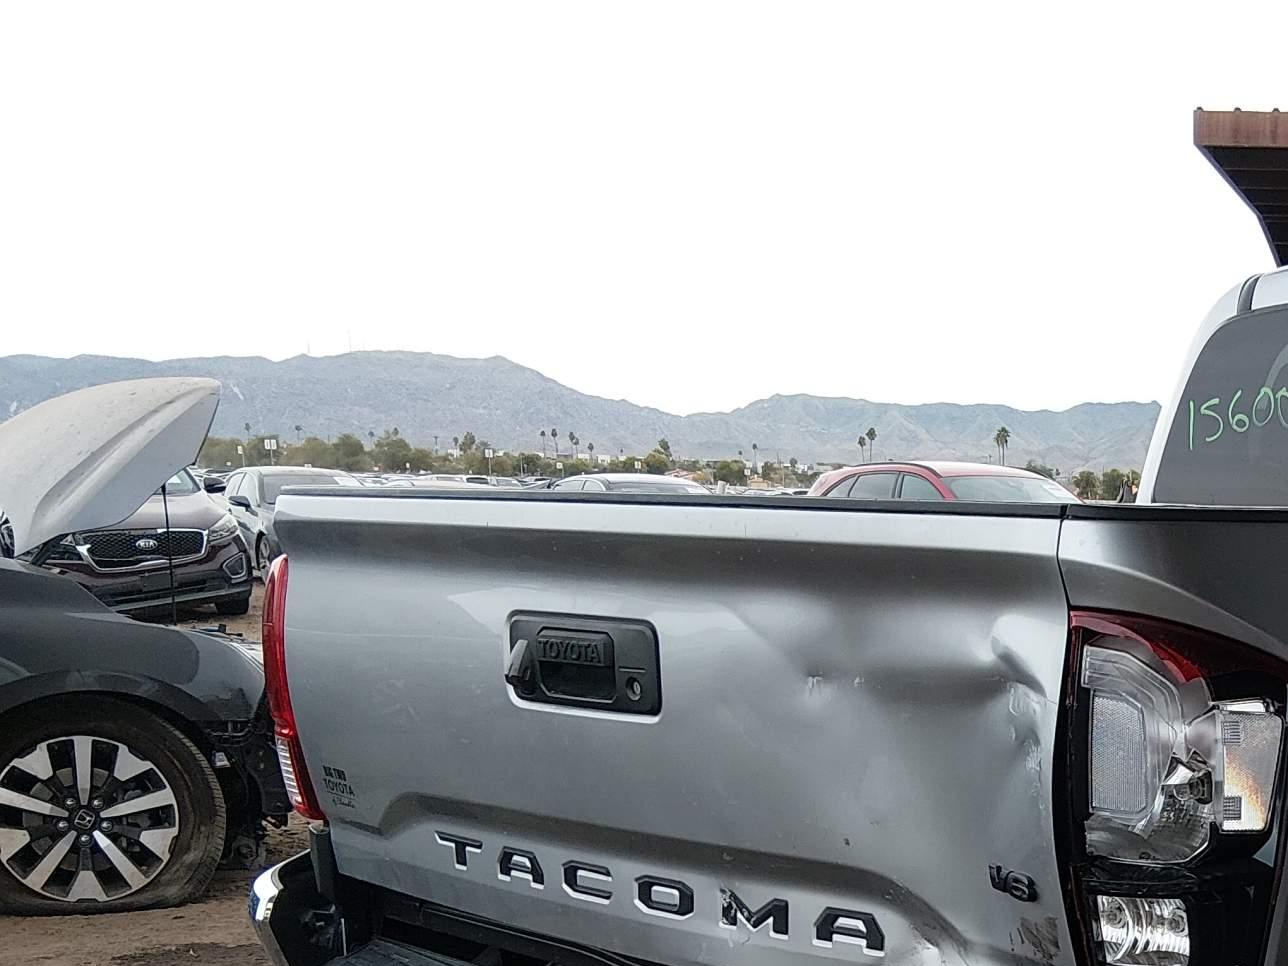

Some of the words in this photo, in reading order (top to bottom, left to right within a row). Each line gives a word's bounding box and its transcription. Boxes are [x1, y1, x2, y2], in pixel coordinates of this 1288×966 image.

[538, 639, 602, 663] TOYOTA
[322, 778, 356, 797] TOYOTA
[434, 830, 886, 957] TACOMA
